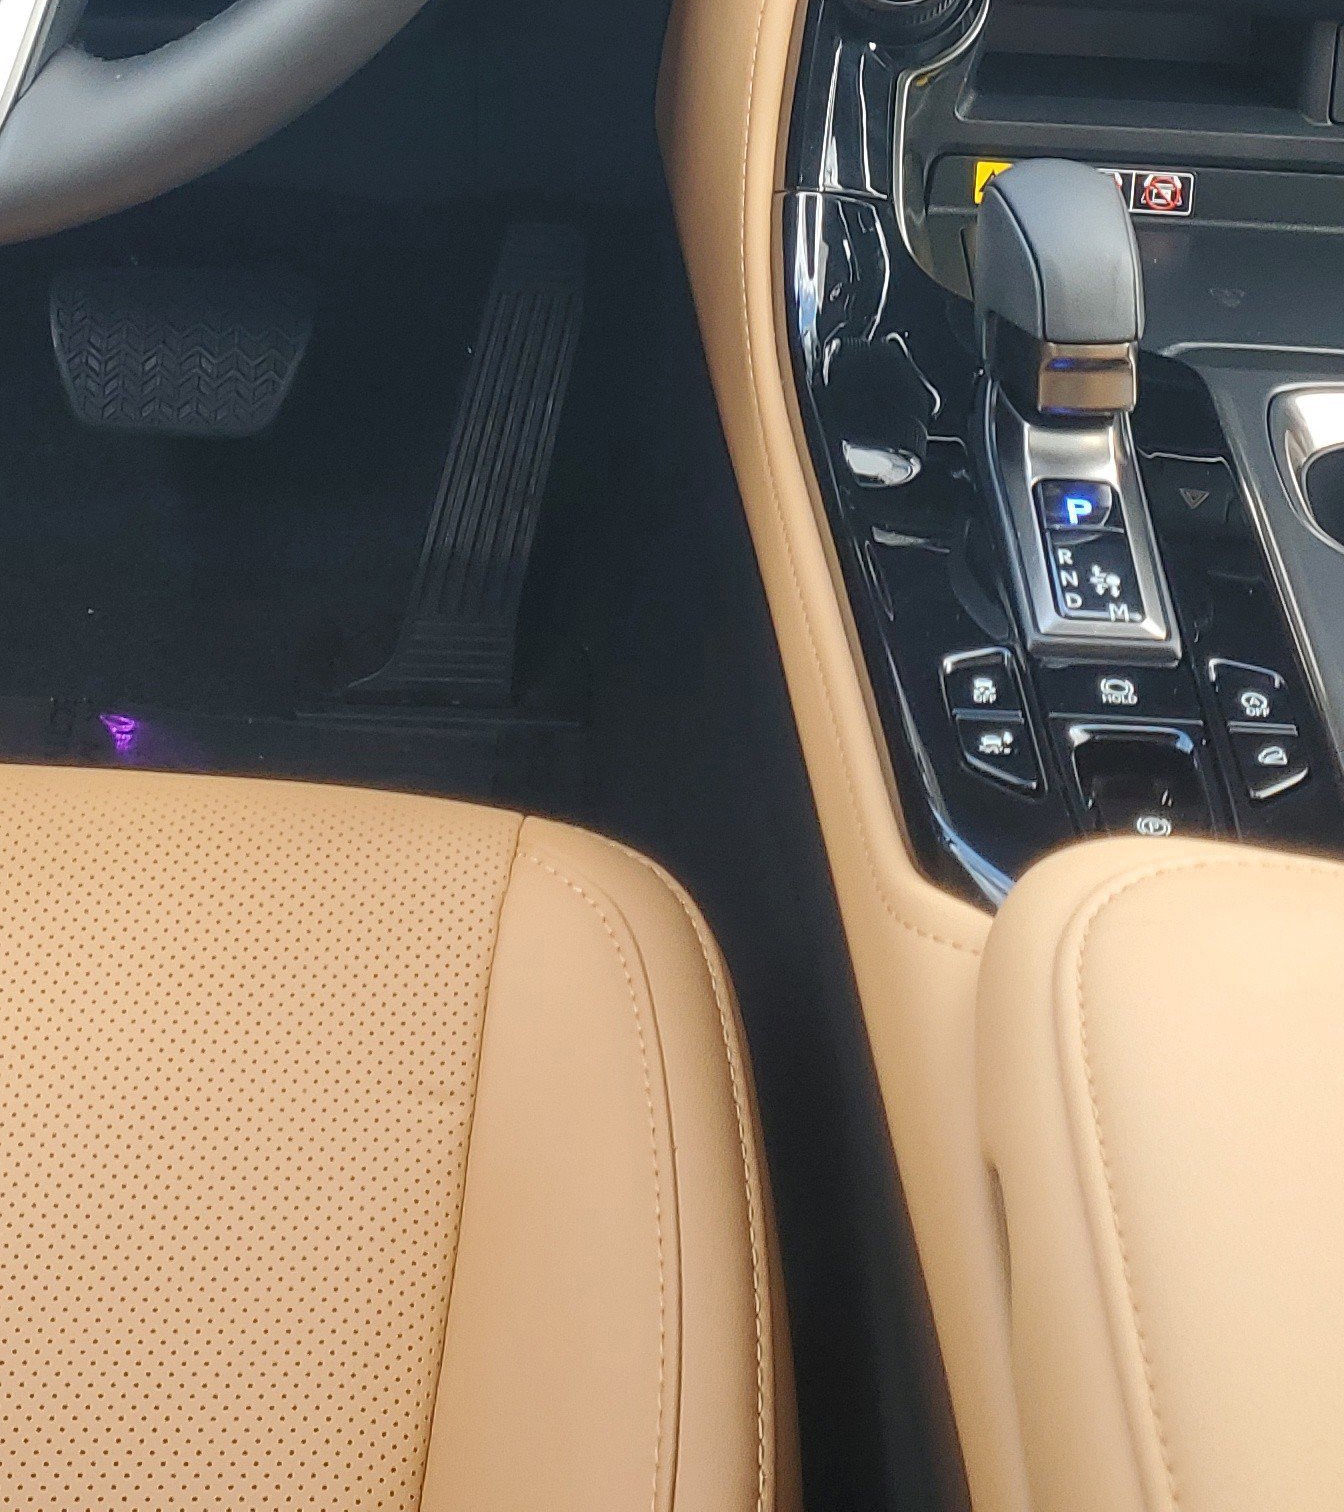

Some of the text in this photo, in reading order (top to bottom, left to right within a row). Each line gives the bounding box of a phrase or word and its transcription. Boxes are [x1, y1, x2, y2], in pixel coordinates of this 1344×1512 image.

[1066, 497, 1093, 525] P
[1058, 548, 1073, 565] R
[1060, 569, 1079, 587] N
[1065, 592, 1083, 610] D
[1108, 602, 1130, 622] M
